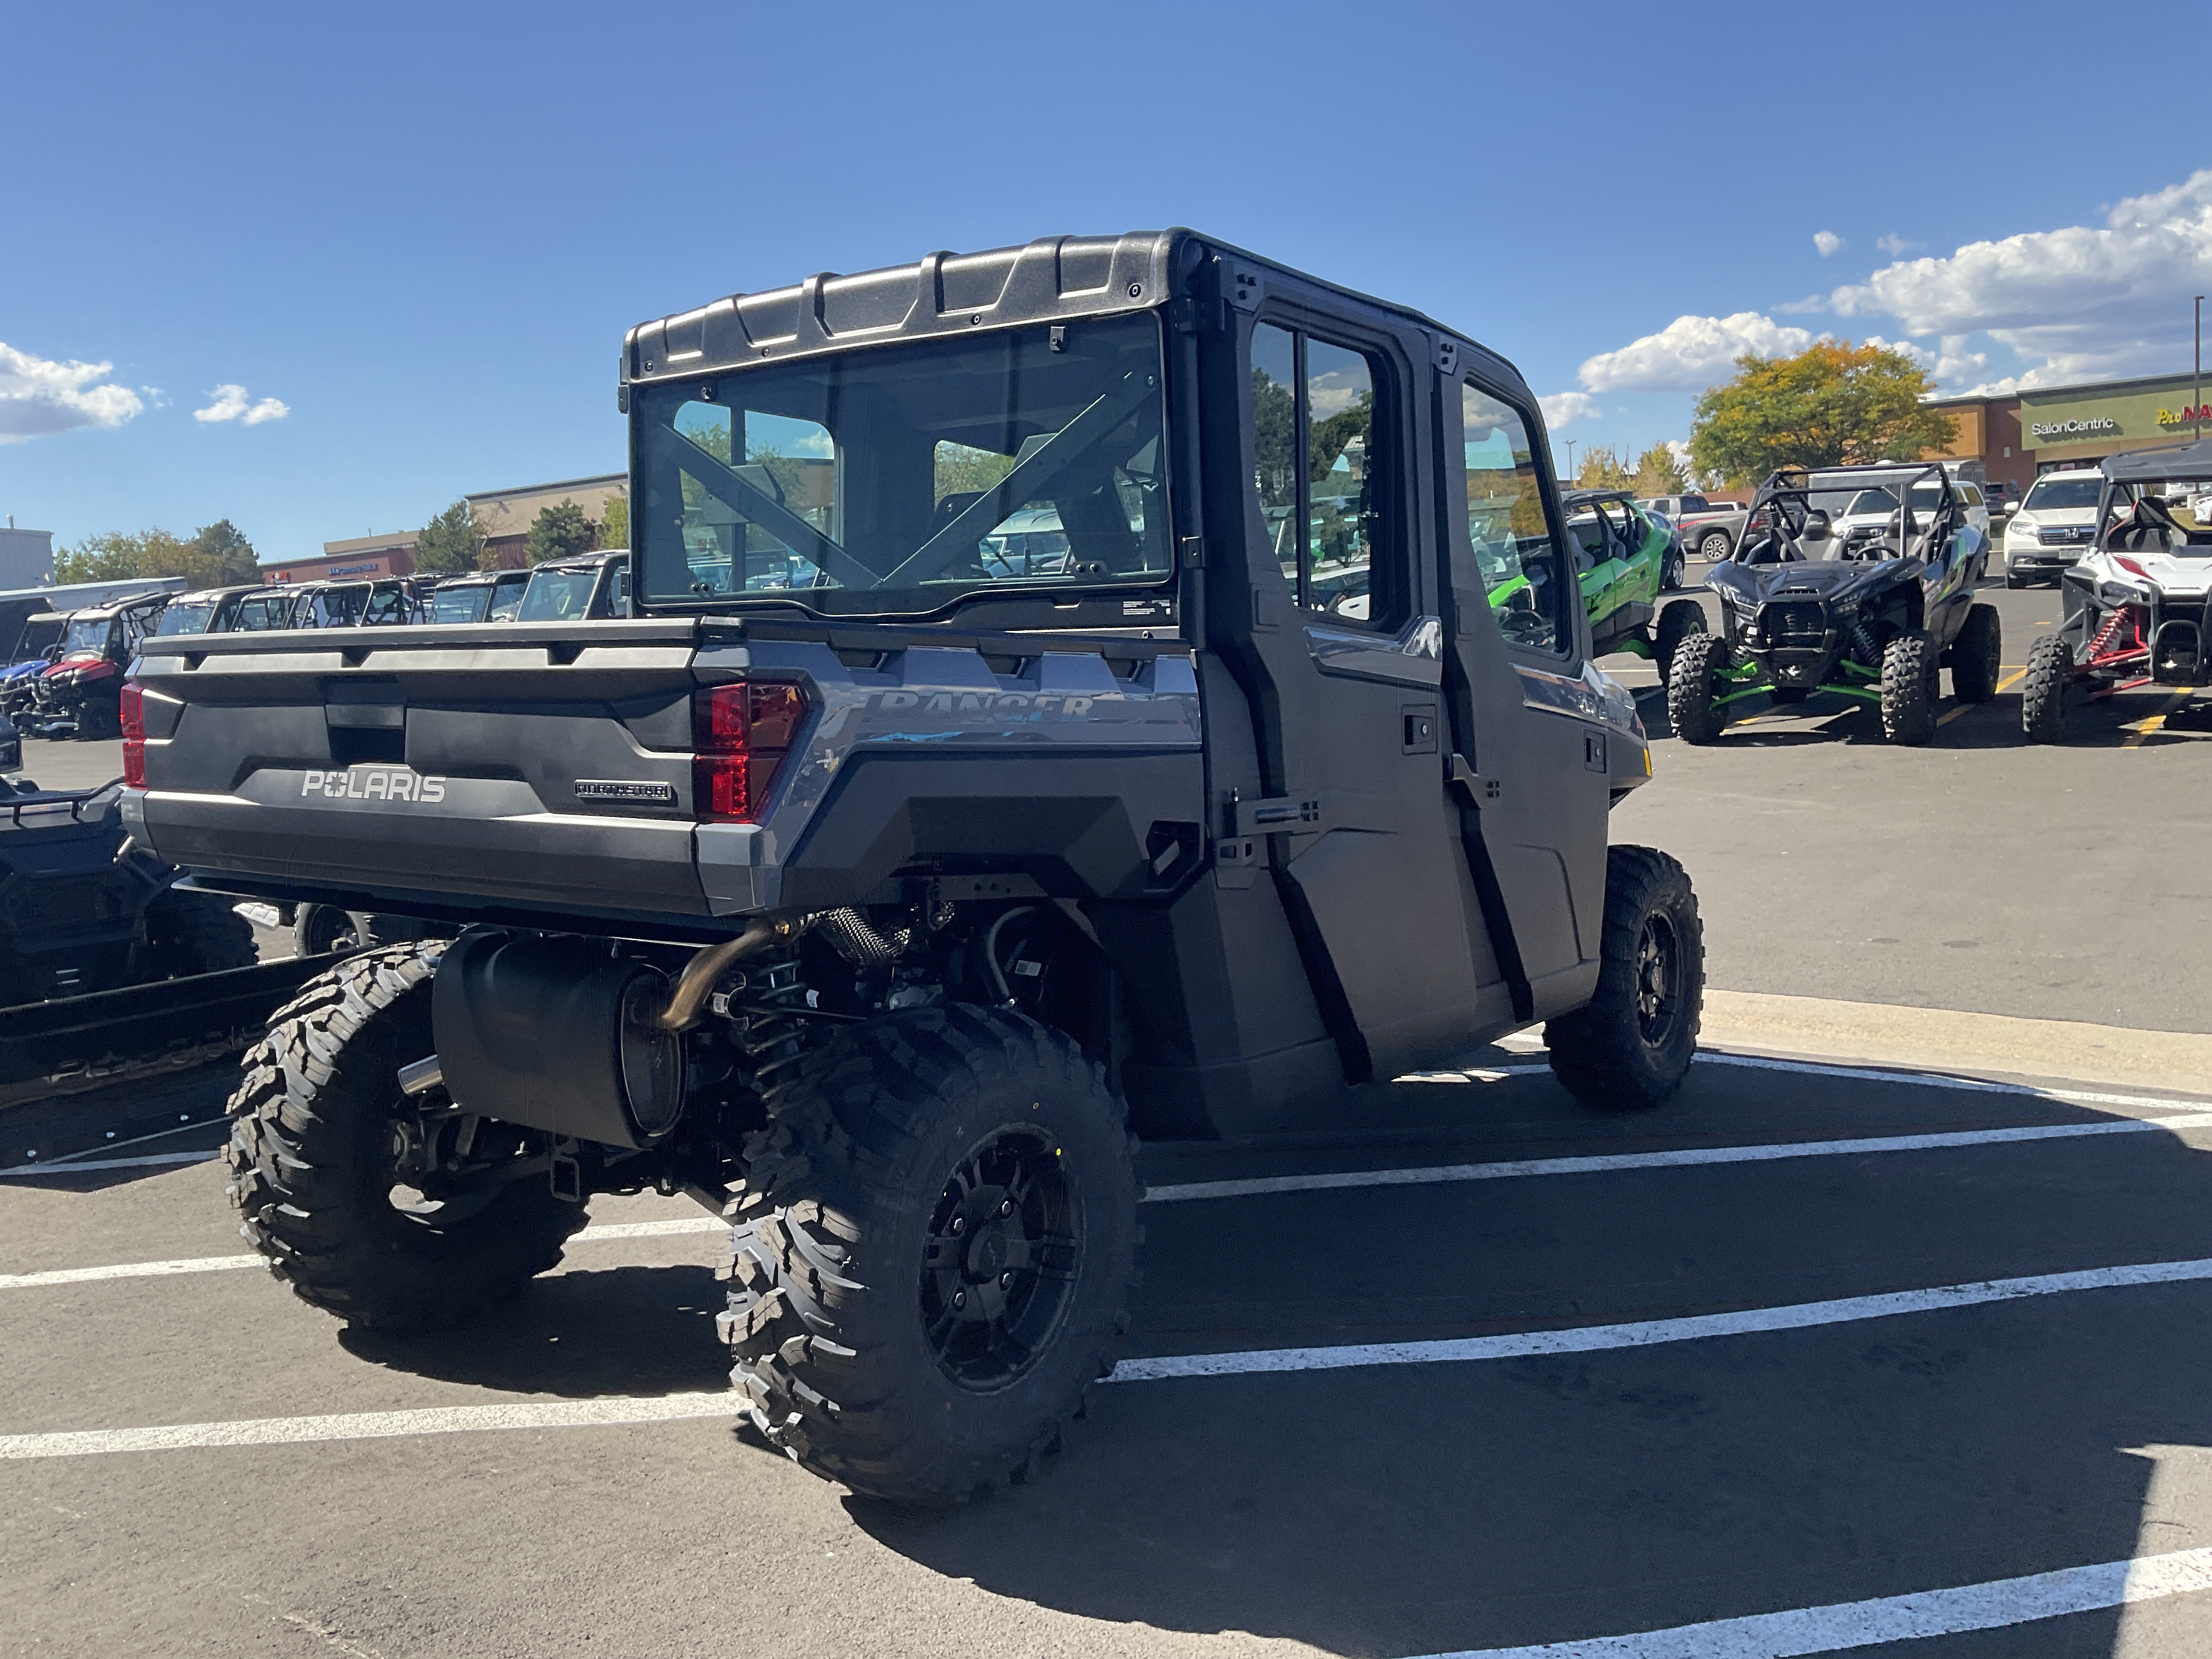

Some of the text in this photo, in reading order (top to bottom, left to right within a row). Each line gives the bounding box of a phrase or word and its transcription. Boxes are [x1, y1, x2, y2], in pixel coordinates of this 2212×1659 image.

[2032, 417, 2113, 435] SalonCentric
[2156, 408, 2182, 424] Pro
[874, 691, 1093, 723] RANGER
[301, 770, 446, 803] POLARIS
